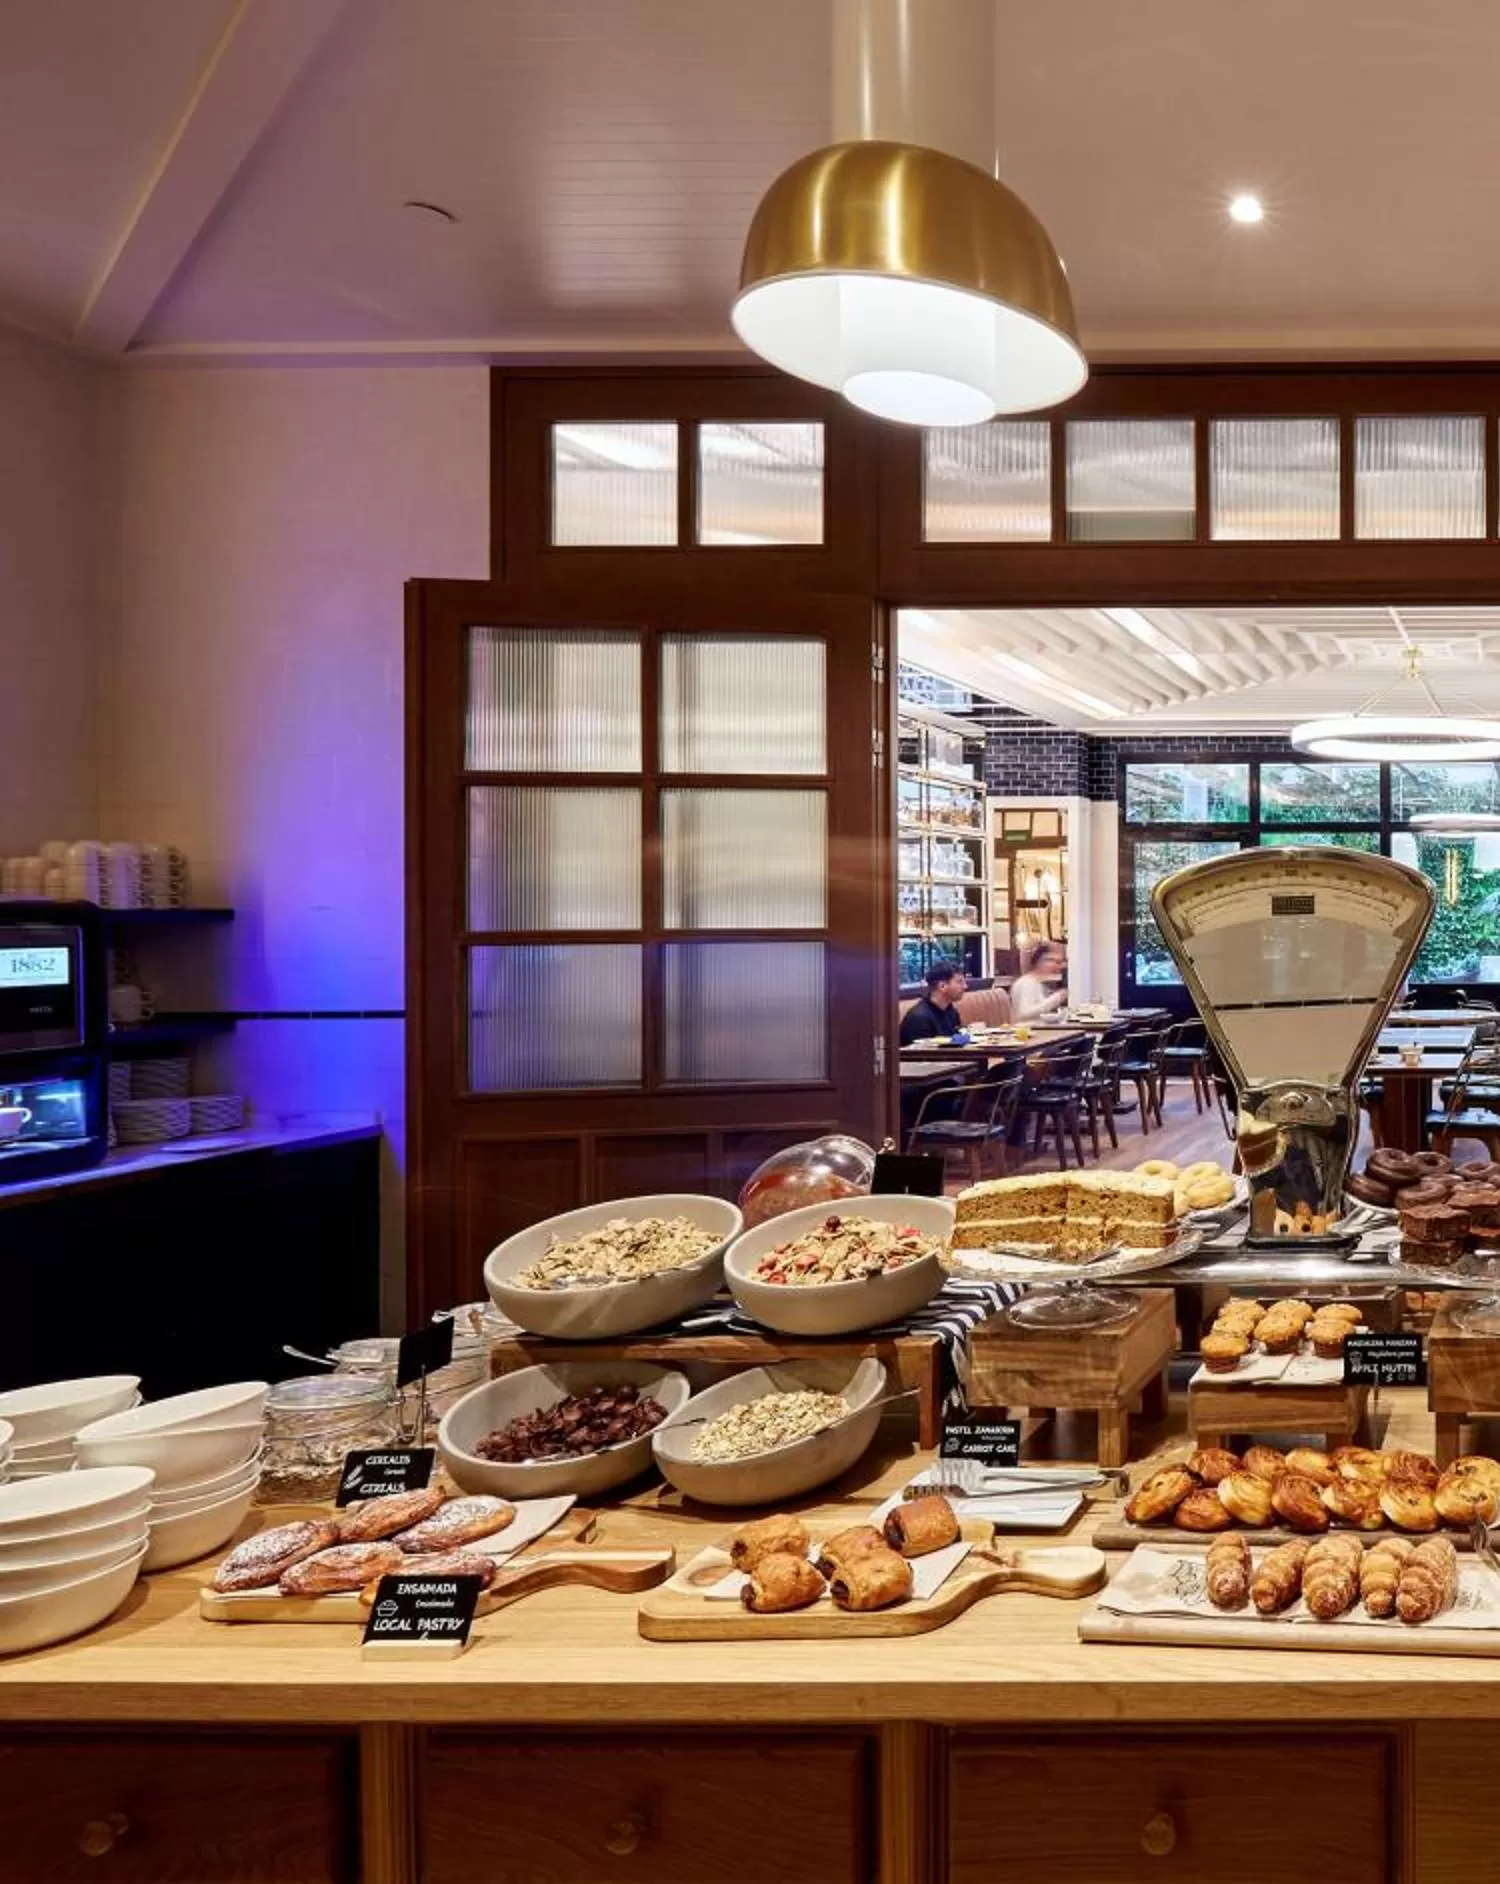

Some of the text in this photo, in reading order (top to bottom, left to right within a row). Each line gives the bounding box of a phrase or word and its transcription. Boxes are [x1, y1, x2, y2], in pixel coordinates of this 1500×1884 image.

[995, 1443, 1017, 1453] CAKE
[373, 1618, 465, 1631] LOCAL PASTRY
